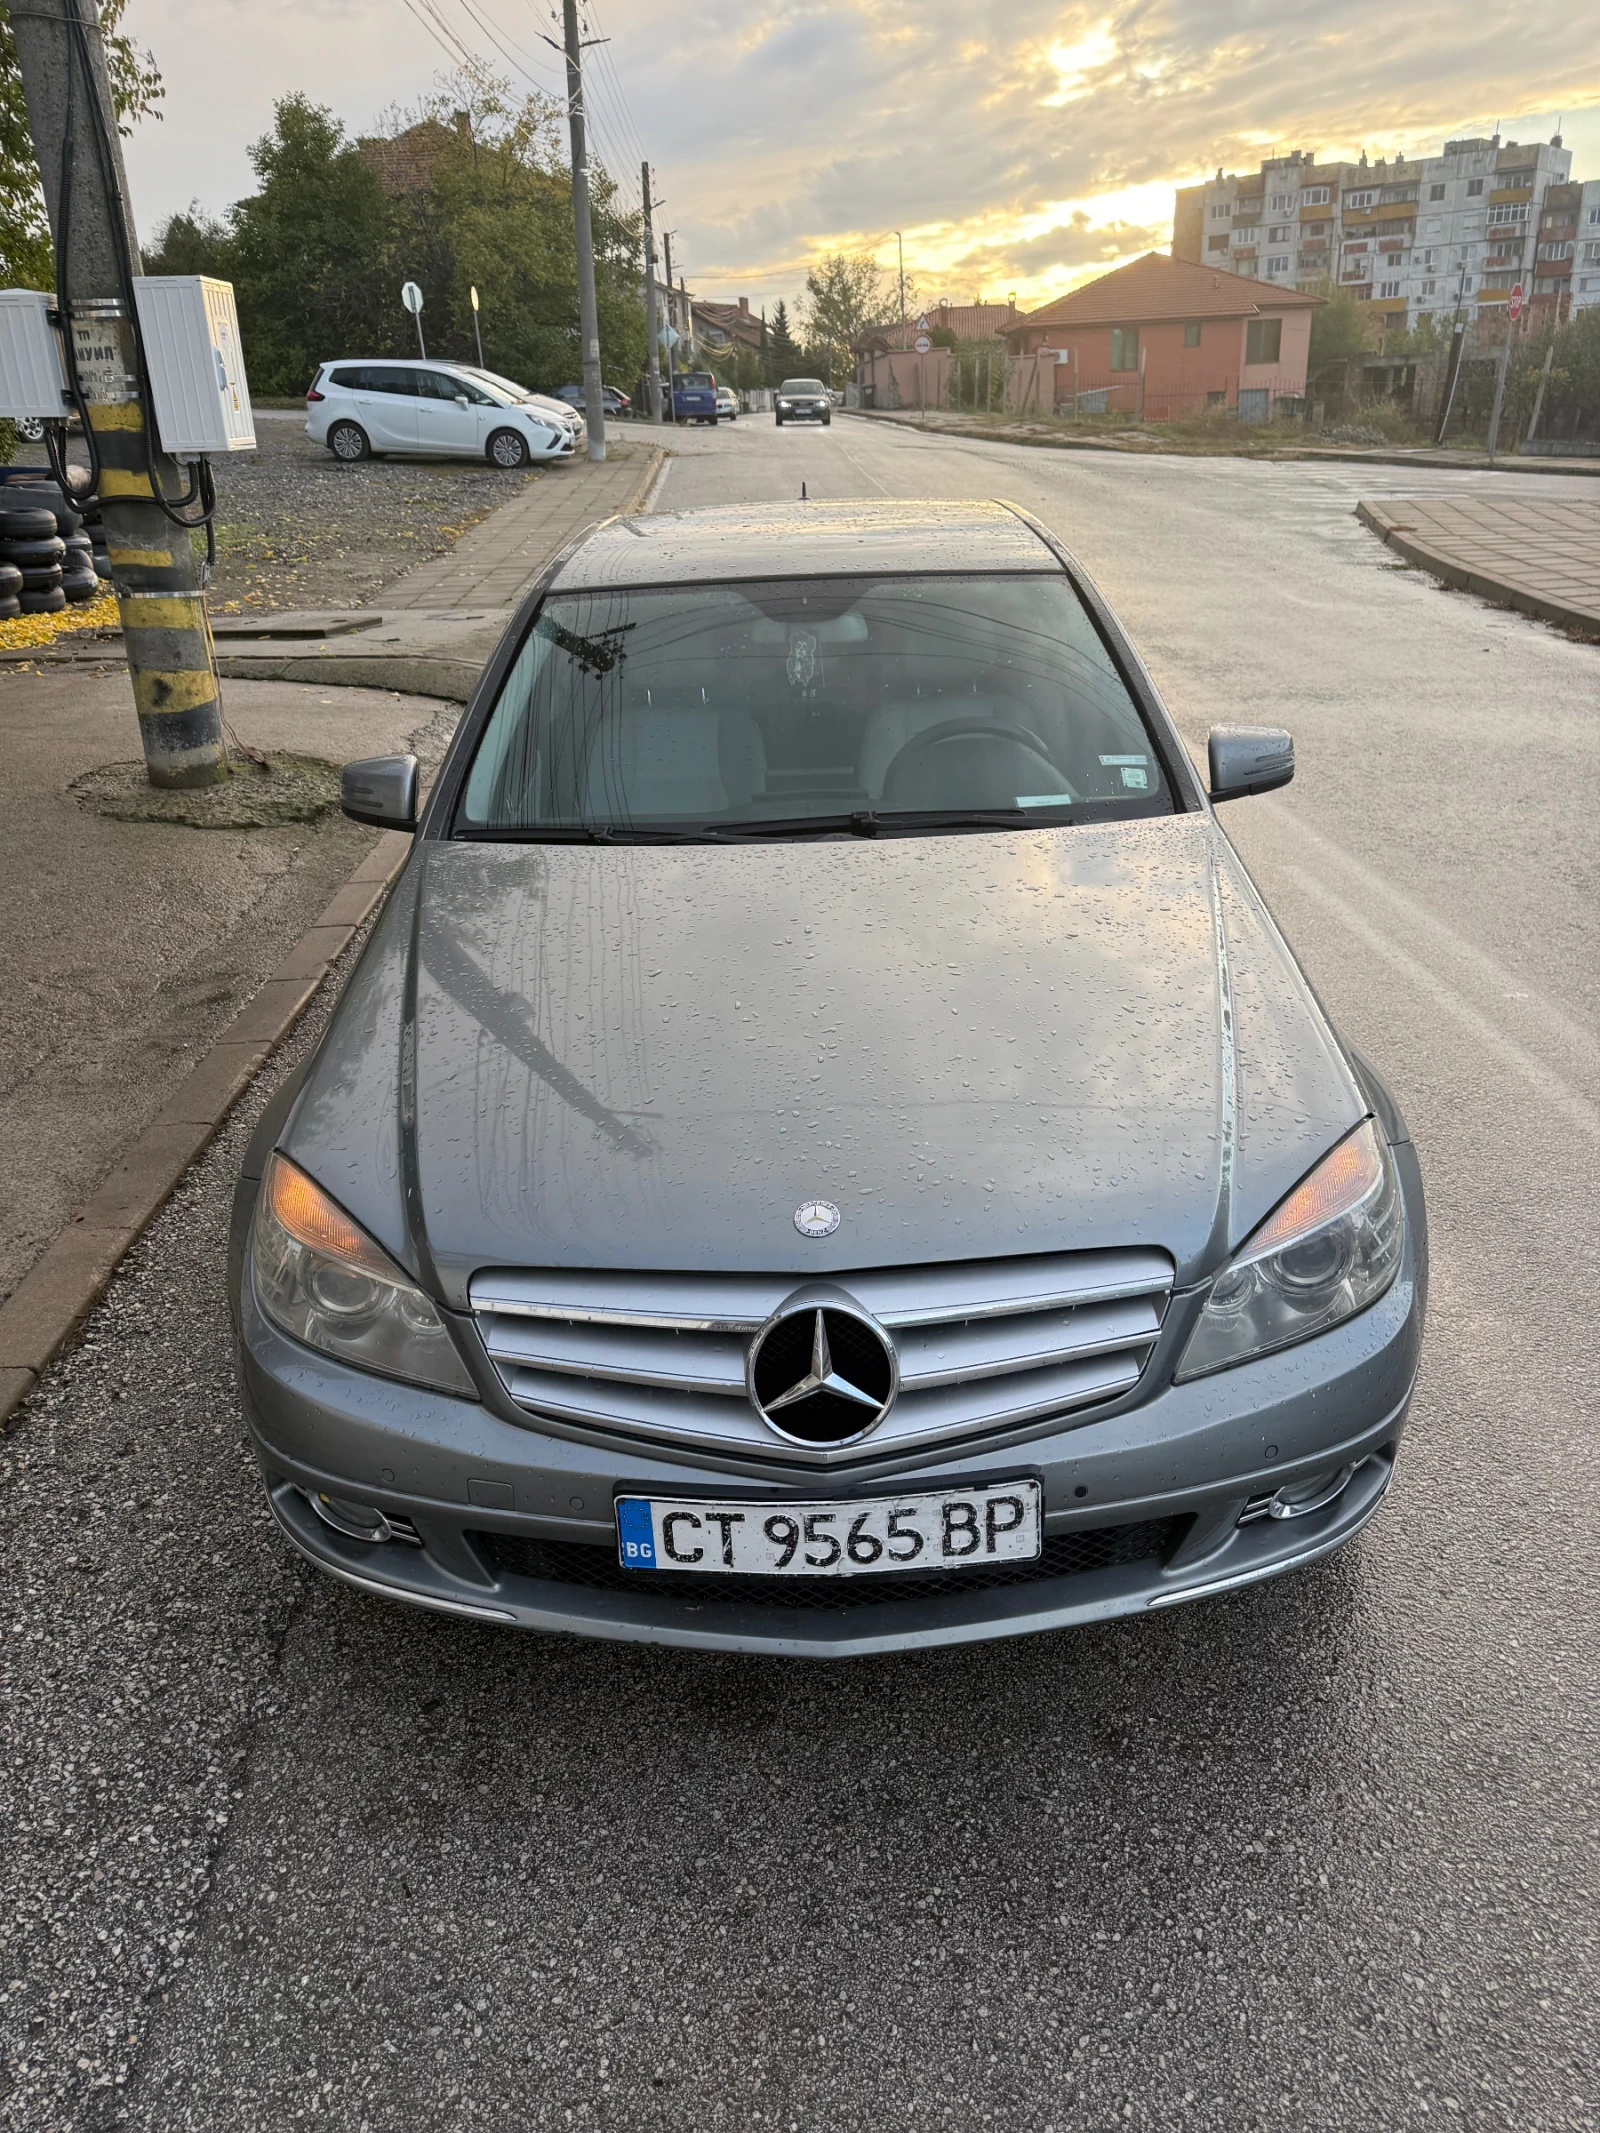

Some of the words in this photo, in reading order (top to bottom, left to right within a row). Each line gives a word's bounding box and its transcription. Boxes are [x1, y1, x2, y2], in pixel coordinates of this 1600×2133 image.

[1510, 296, 1522, 309] STOP
[662, 1511, 746, 1567] CT
[763, 1507, 924, 1568] 9565
[941, 1495, 1025, 1557] BP
[626, 1541, 652, 1558] BG
